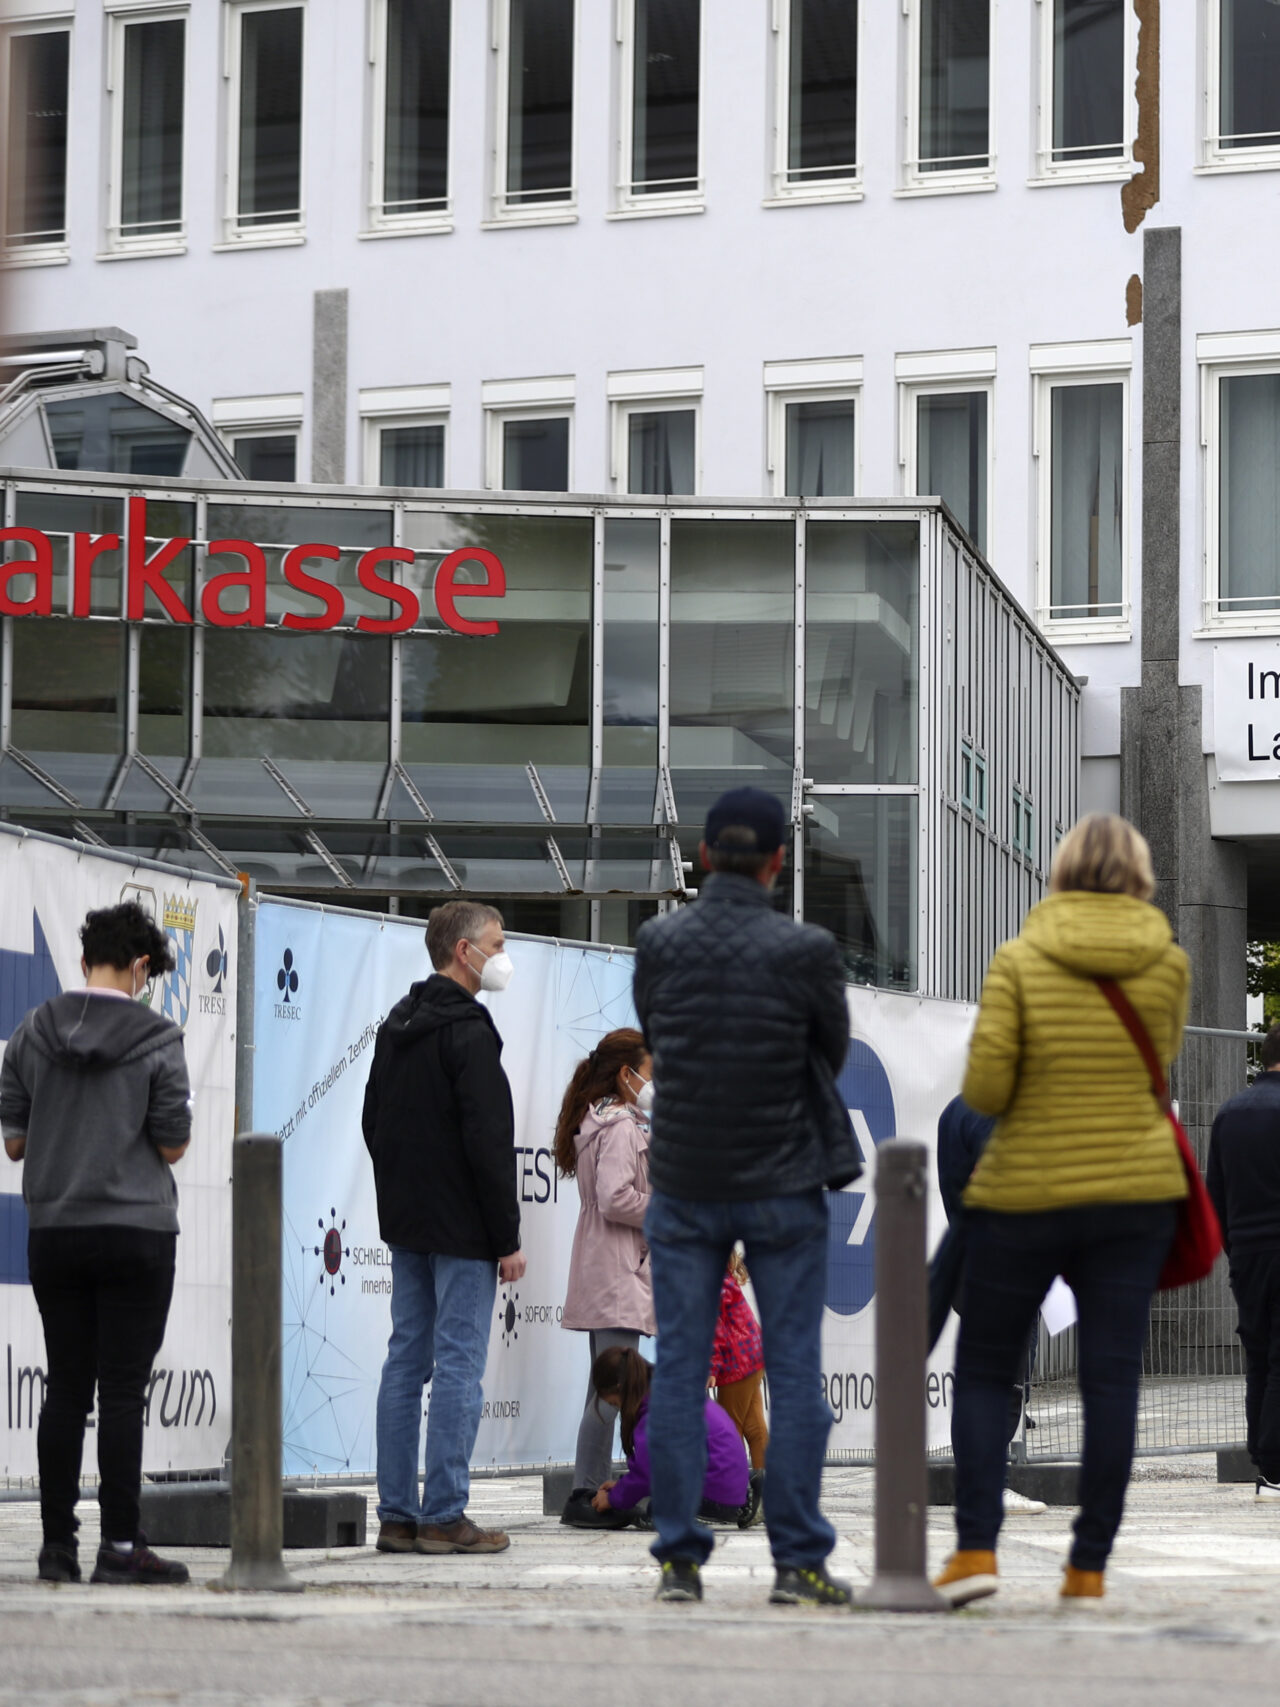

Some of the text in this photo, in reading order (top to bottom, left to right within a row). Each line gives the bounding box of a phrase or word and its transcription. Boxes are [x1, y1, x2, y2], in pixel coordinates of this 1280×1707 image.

[273, 1003, 302, 1021] TRESEC
[294, 1097, 308, 1127] mit
[307, 1056, 348, 1109] offiziellem
[492, 1400, 520, 1418] KINDER
